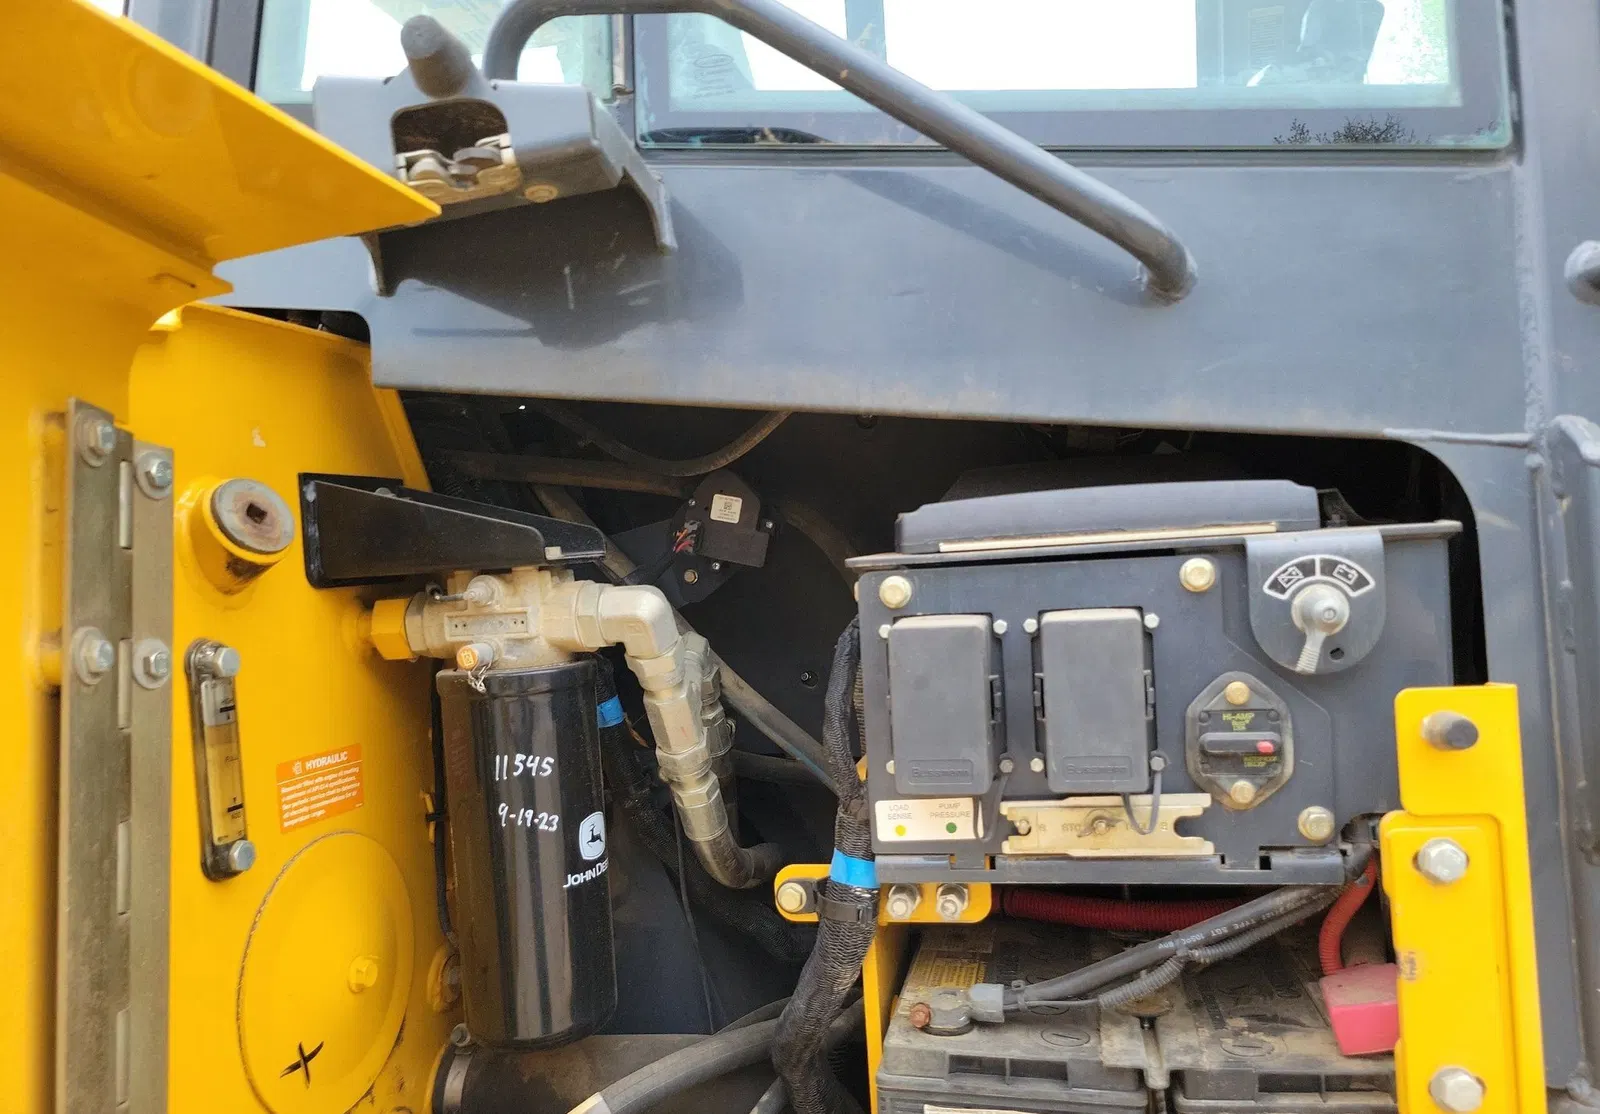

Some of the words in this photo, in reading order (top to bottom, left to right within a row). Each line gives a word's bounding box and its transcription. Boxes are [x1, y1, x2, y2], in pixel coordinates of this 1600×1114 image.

[305, 751, 348, 770] HYDRAULIC
[495, 753, 555, 781] 11545
[889, 804, 910, 812] LOAD
[938, 802, 961, 810] PUMP
[498, 802, 560, 832] 9-19-23
[929, 810, 972, 819] PRESSURE
[562, 867, 596, 888] JOHN
[1232, 918, 1256, 930] TYPE
[1210, 926, 1229, 937] SGT
